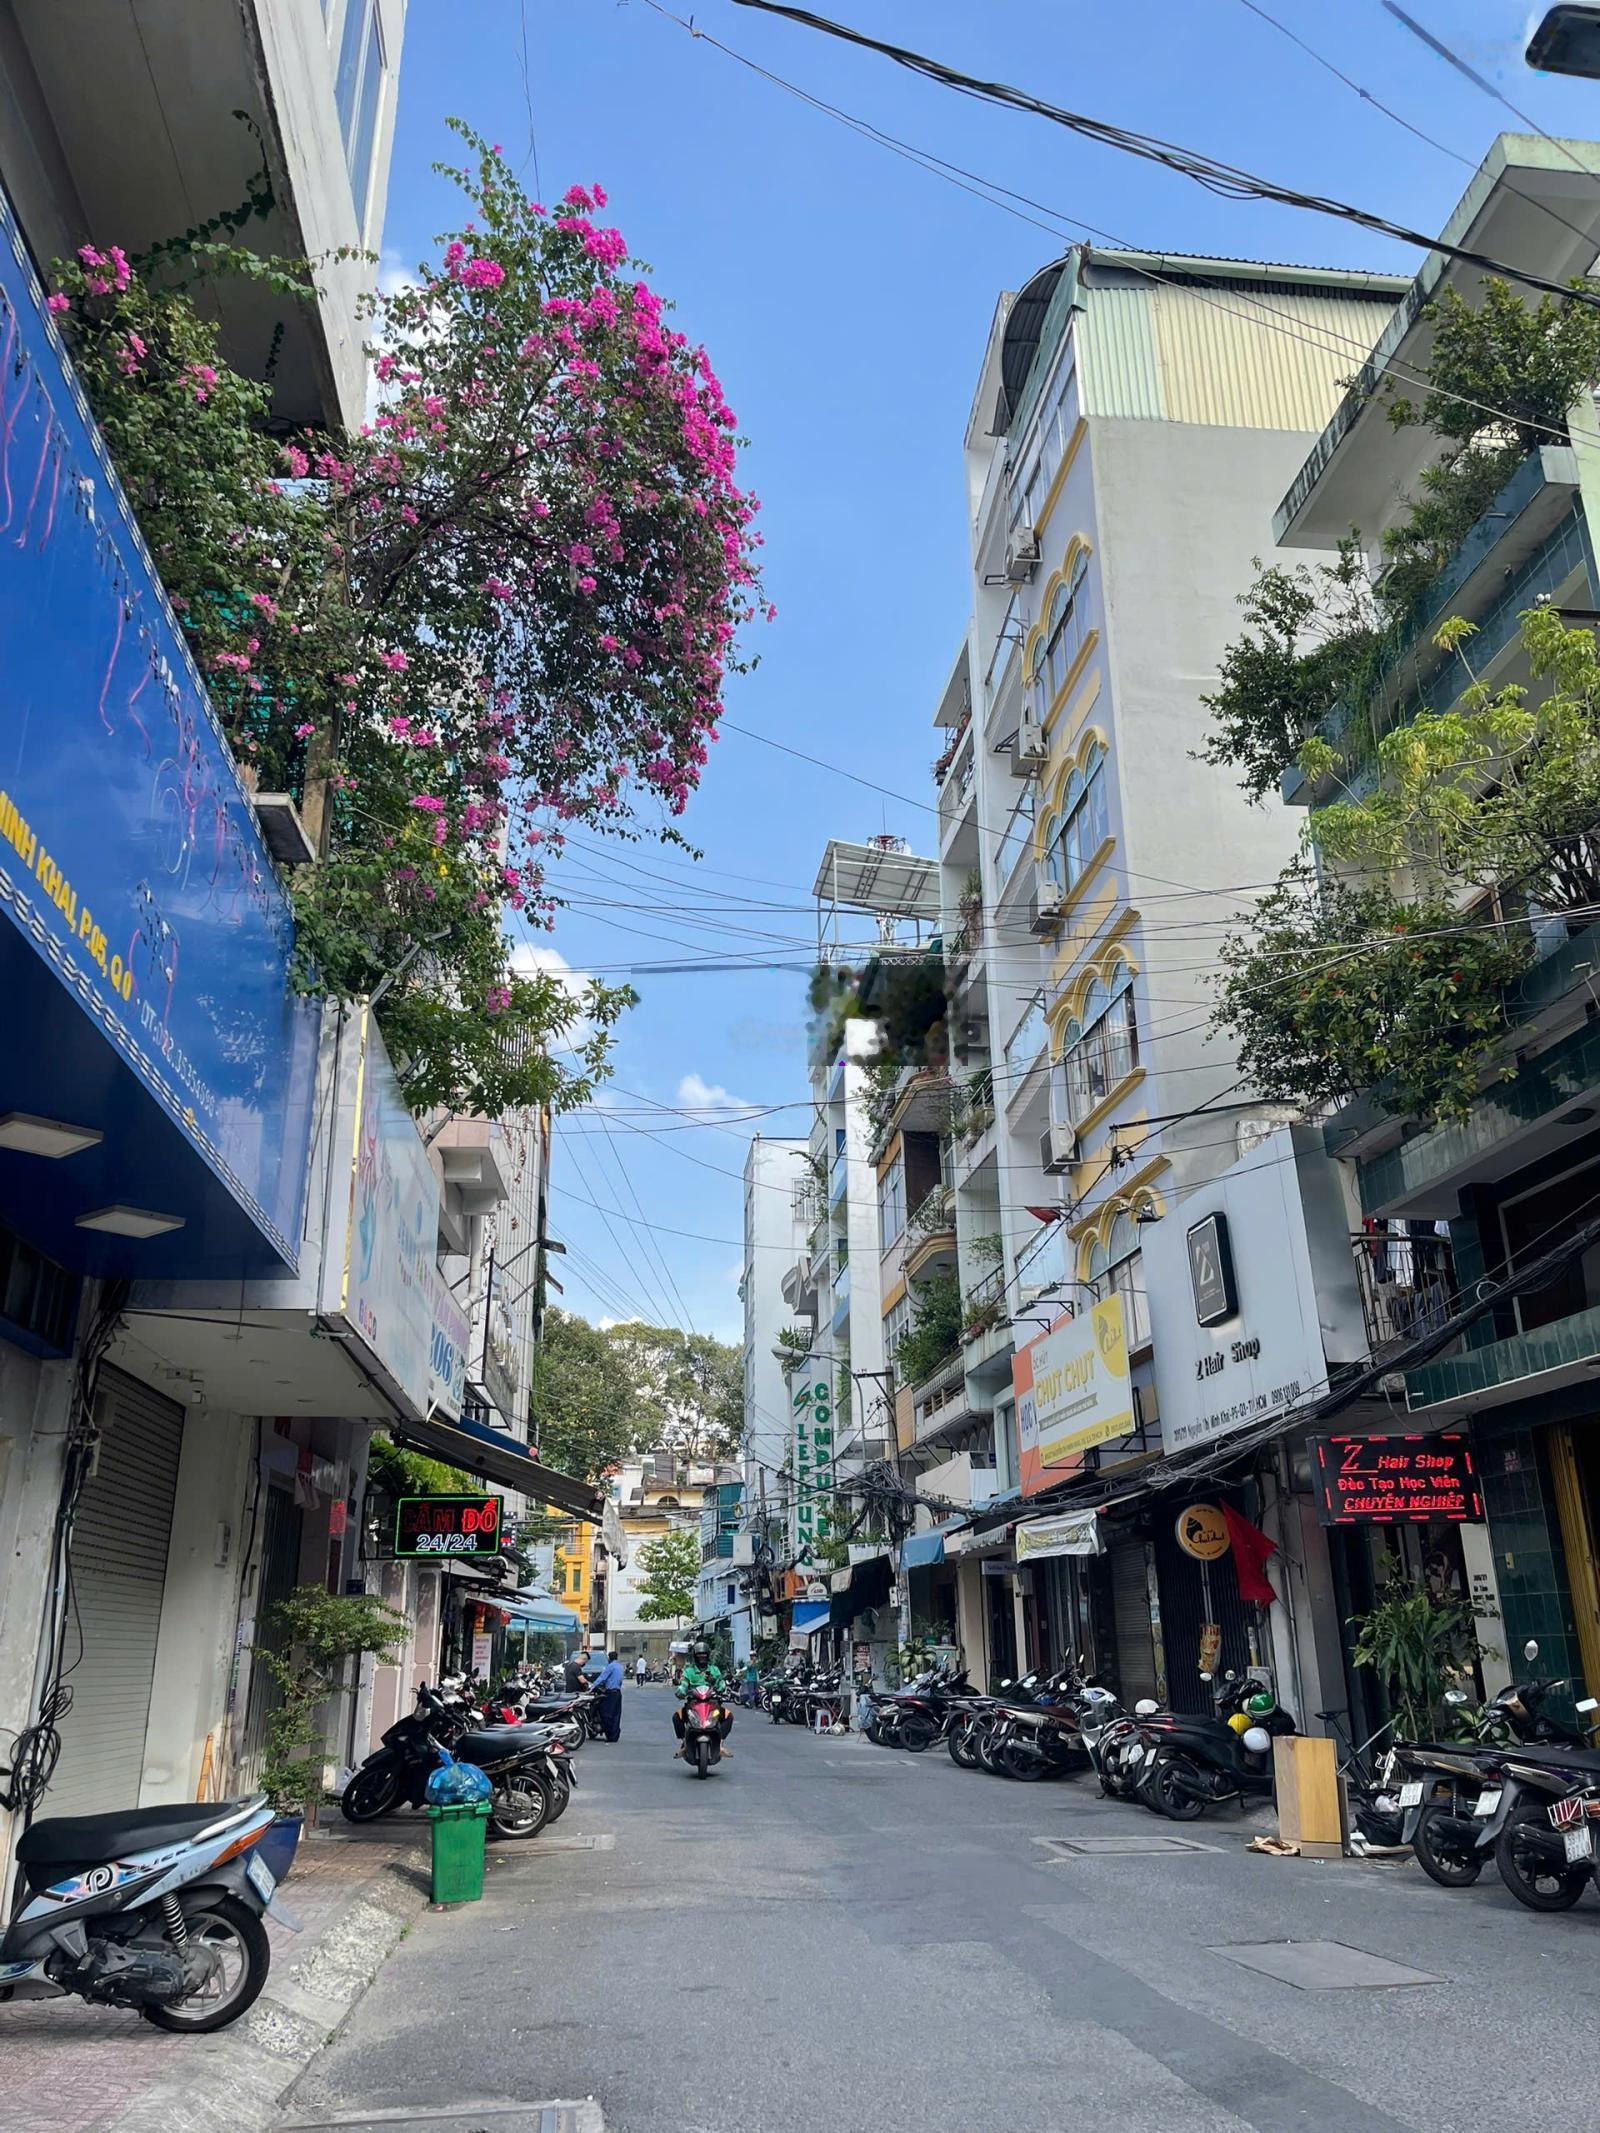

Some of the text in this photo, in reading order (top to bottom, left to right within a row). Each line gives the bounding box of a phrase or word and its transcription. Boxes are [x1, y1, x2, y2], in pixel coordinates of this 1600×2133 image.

[430, 1322, 453, 1387] 06
[1195, 1336, 1261, 1381] Z Hair Shop
[1036, 1350, 1094, 1408] CHỤT CHỤT
[814, 1382, 831, 1538] COMPUTE
[1340, 1444, 1454, 1471] Z Hair Shop
[1337, 1474, 1460, 1492] Đào Tạo Học Viên
[402, 1499, 497, 1532] CẦM ĐỒ
[1344, 1492, 1405, 1510] CHUYÊN
[416, 1534, 477, 1551] 24/24
